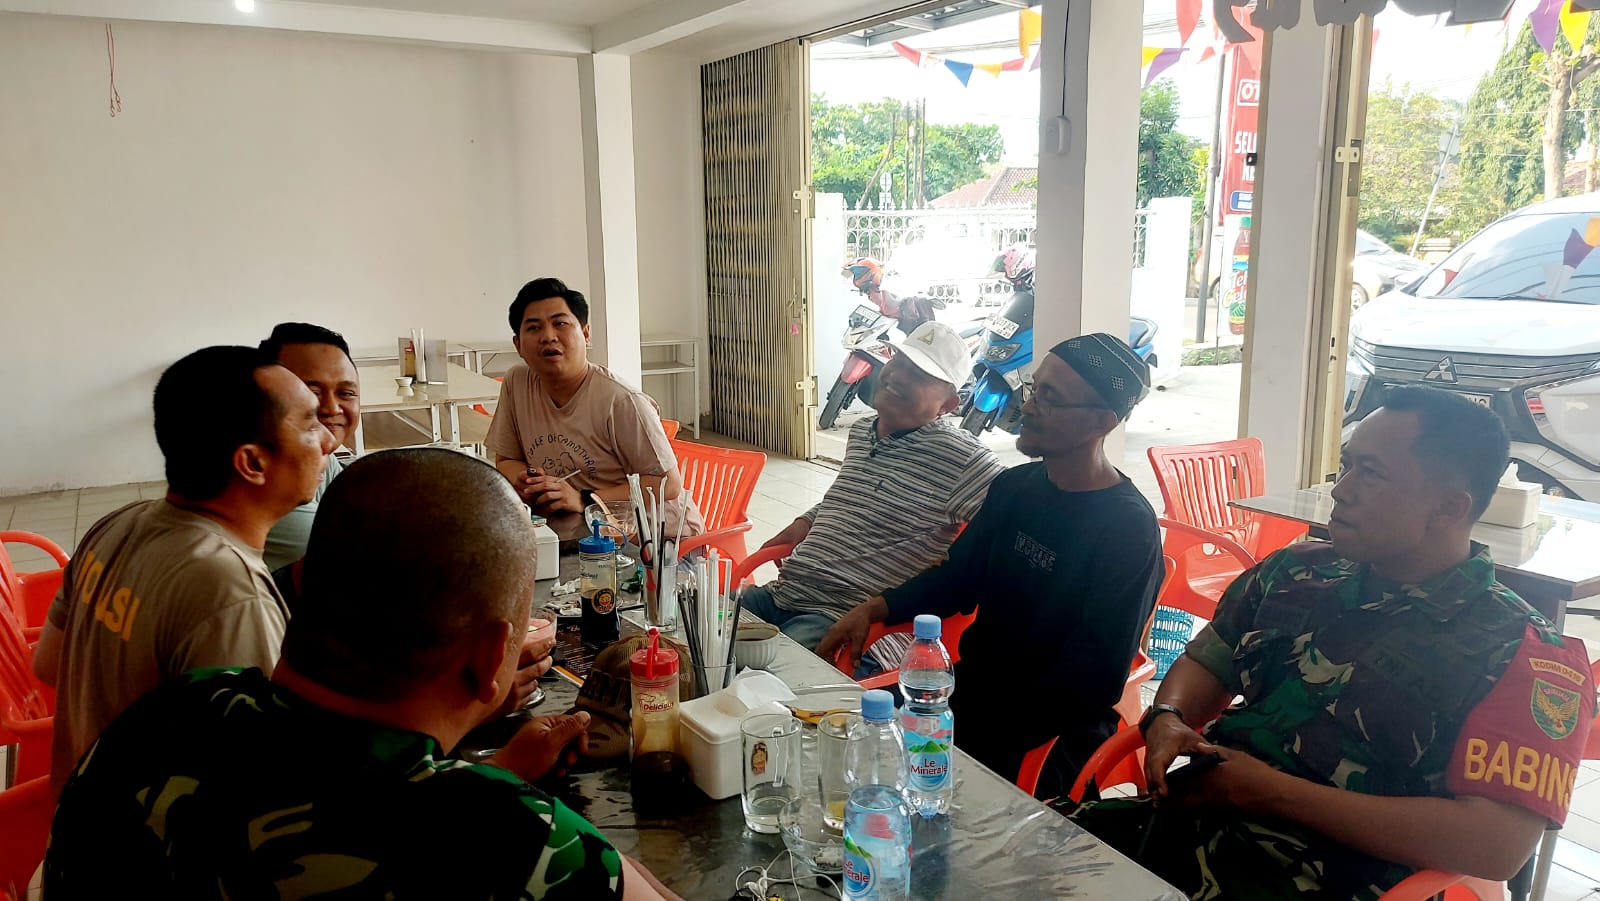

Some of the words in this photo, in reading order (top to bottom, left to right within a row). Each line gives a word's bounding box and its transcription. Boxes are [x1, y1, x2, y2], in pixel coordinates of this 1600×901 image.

[924, 758, 936, 767] Le
[911, 764, 948, 775] Minerale
[844, 866, 870, 882] erale
